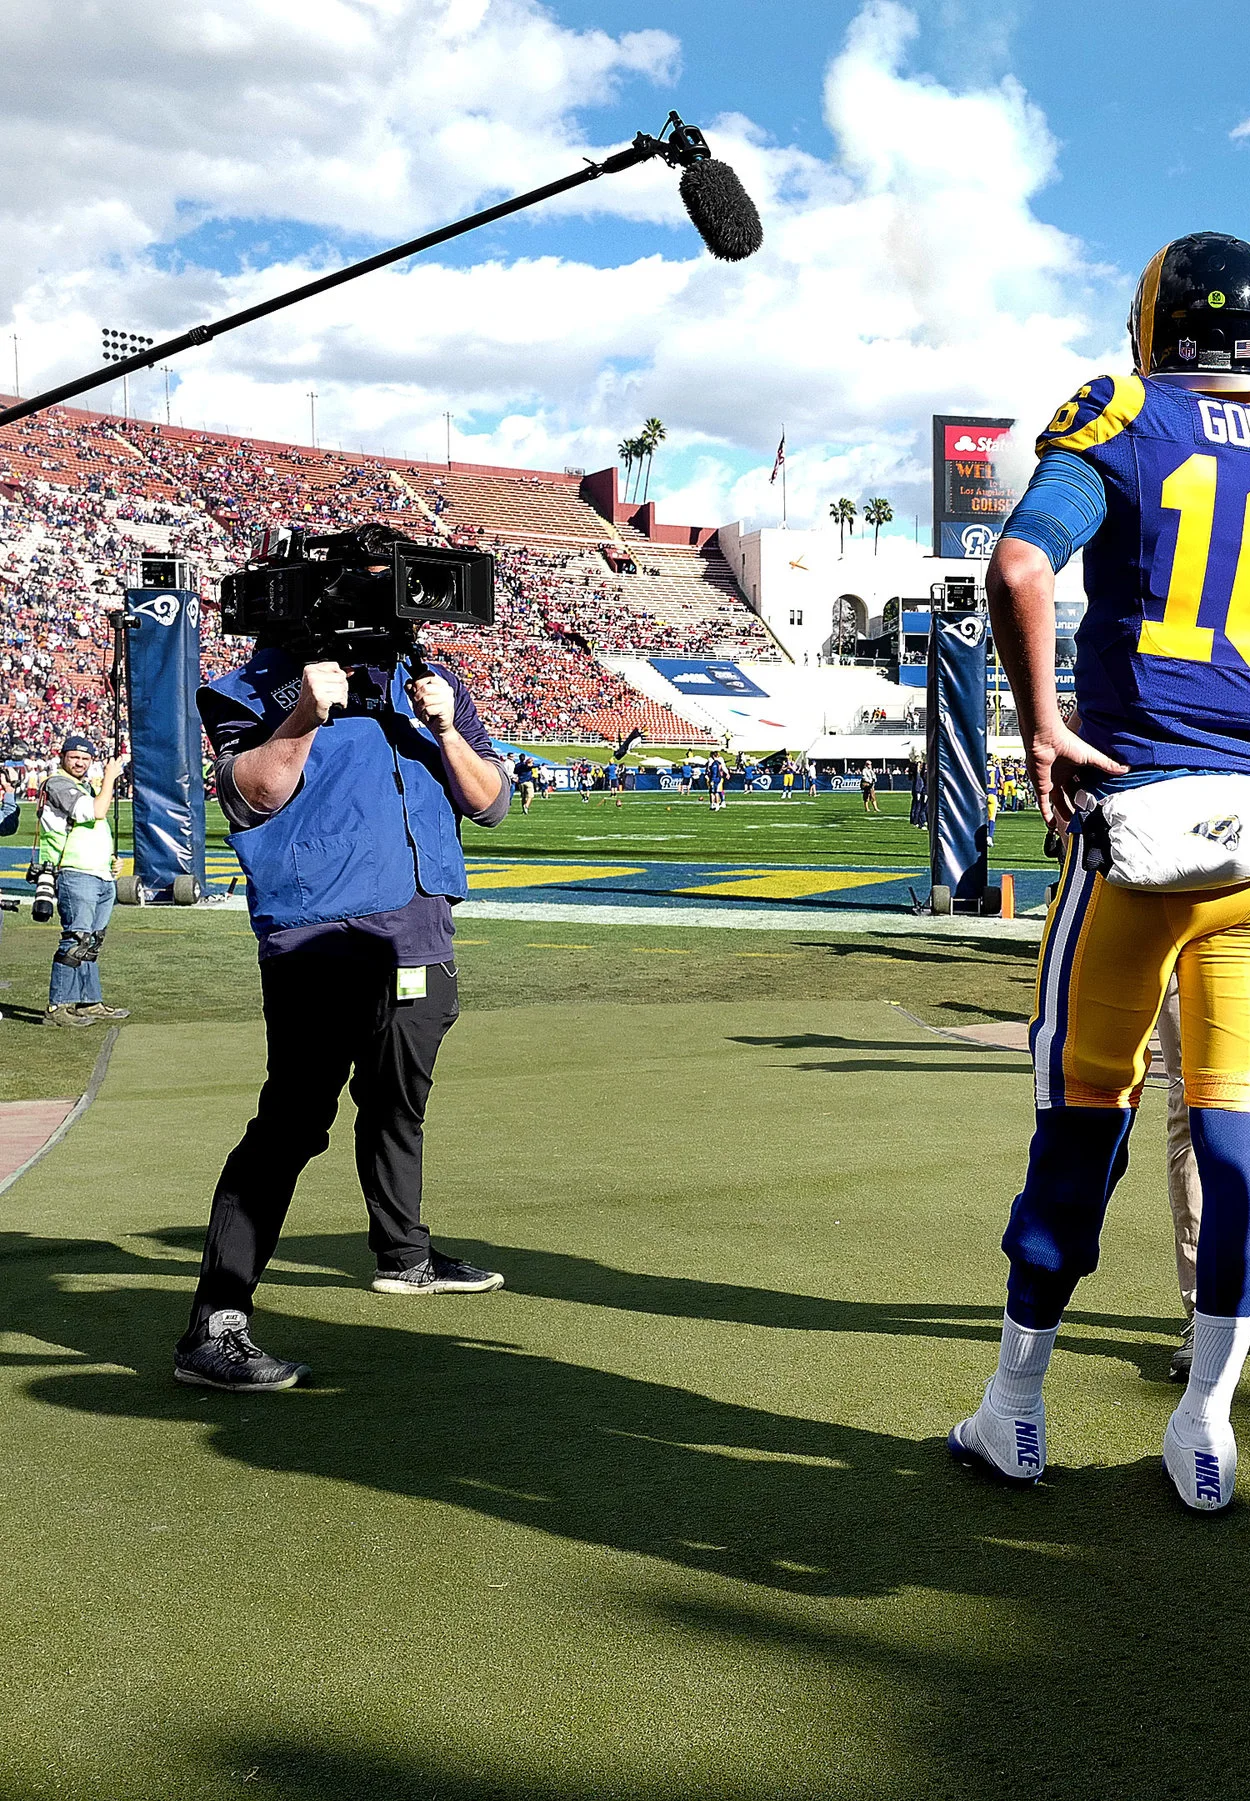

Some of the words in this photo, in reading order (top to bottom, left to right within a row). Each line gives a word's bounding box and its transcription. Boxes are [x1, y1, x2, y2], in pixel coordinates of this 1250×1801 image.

[955, 463, 996, 479] WEL
[960, 486, 974, 495] Los
[971, 497, 1017, 512] COLISE
[274, 684, 301, 708] SD
[1014, 1420, 1040, 1470] NIKE
[1194, 1450, 1222, 1504] NIKE
